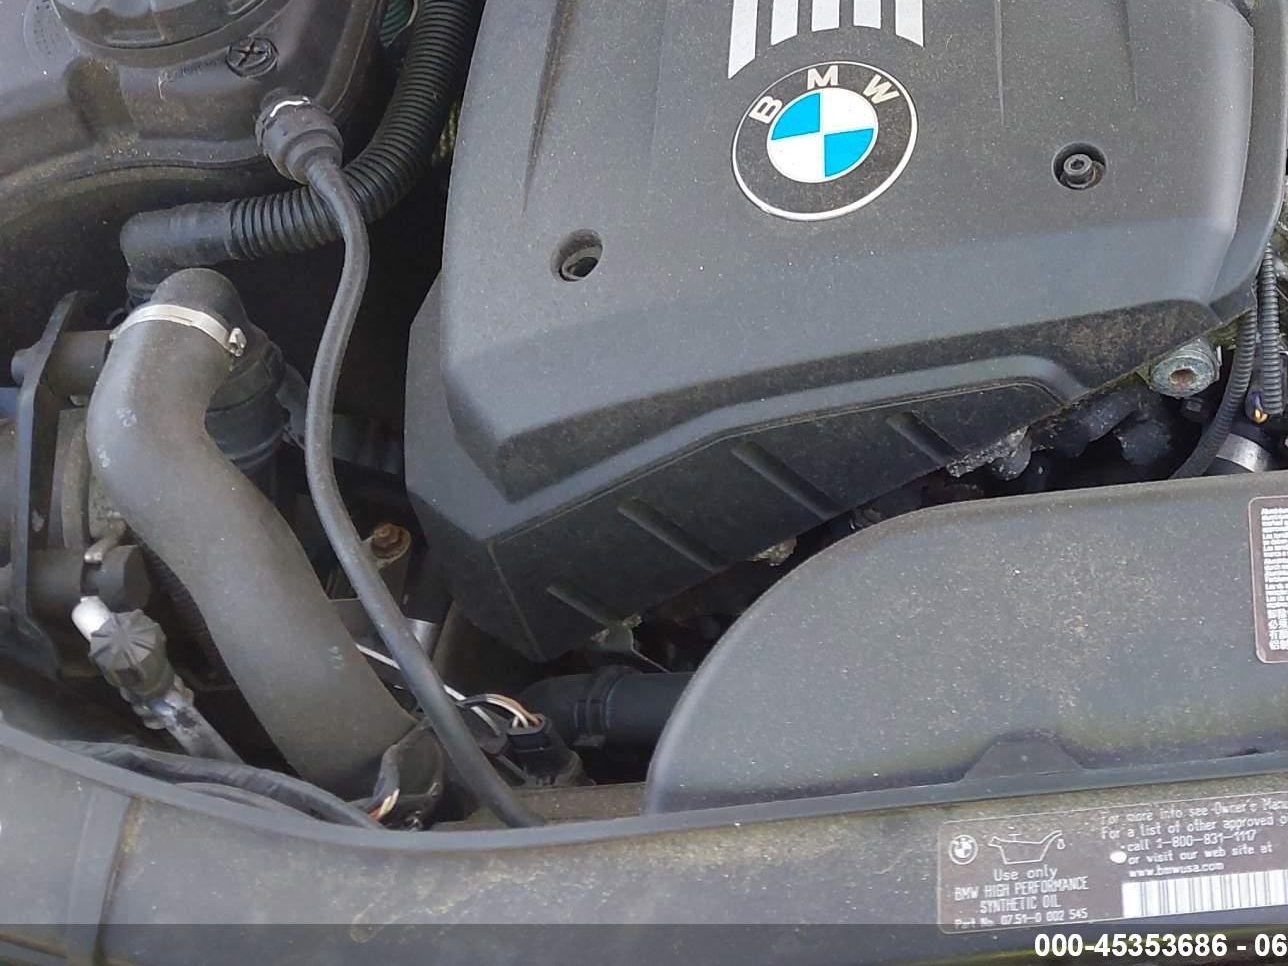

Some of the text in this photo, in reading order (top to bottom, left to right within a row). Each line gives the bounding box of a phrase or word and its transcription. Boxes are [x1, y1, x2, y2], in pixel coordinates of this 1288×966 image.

[749, 64, 901, 124] BMW
[1189, 806, 1208, 816] see
[1101, 825, 1120, 839] For
[1127, 828, 1134, 837] a
[1140, 821, 1161, 836] list
[1167, 819, 1180, 833] of
[1186, 816, 1216, 832] other
[1222, 811, 1273, 831] approved
[1127, 838, 1149, 851] call
[1128, 841, 1272, 864] or visit our web site at
[993, 862, 1057, 881] Use only
[1128, 858, 1224, 878] www.bmwusa.com
[954, 875, 1089, 901] BMW HIGH PERFORMANCE
[979, 893, 1061, 914] SYNTHETIC OIL
[954, 917, 975, 930] Part
